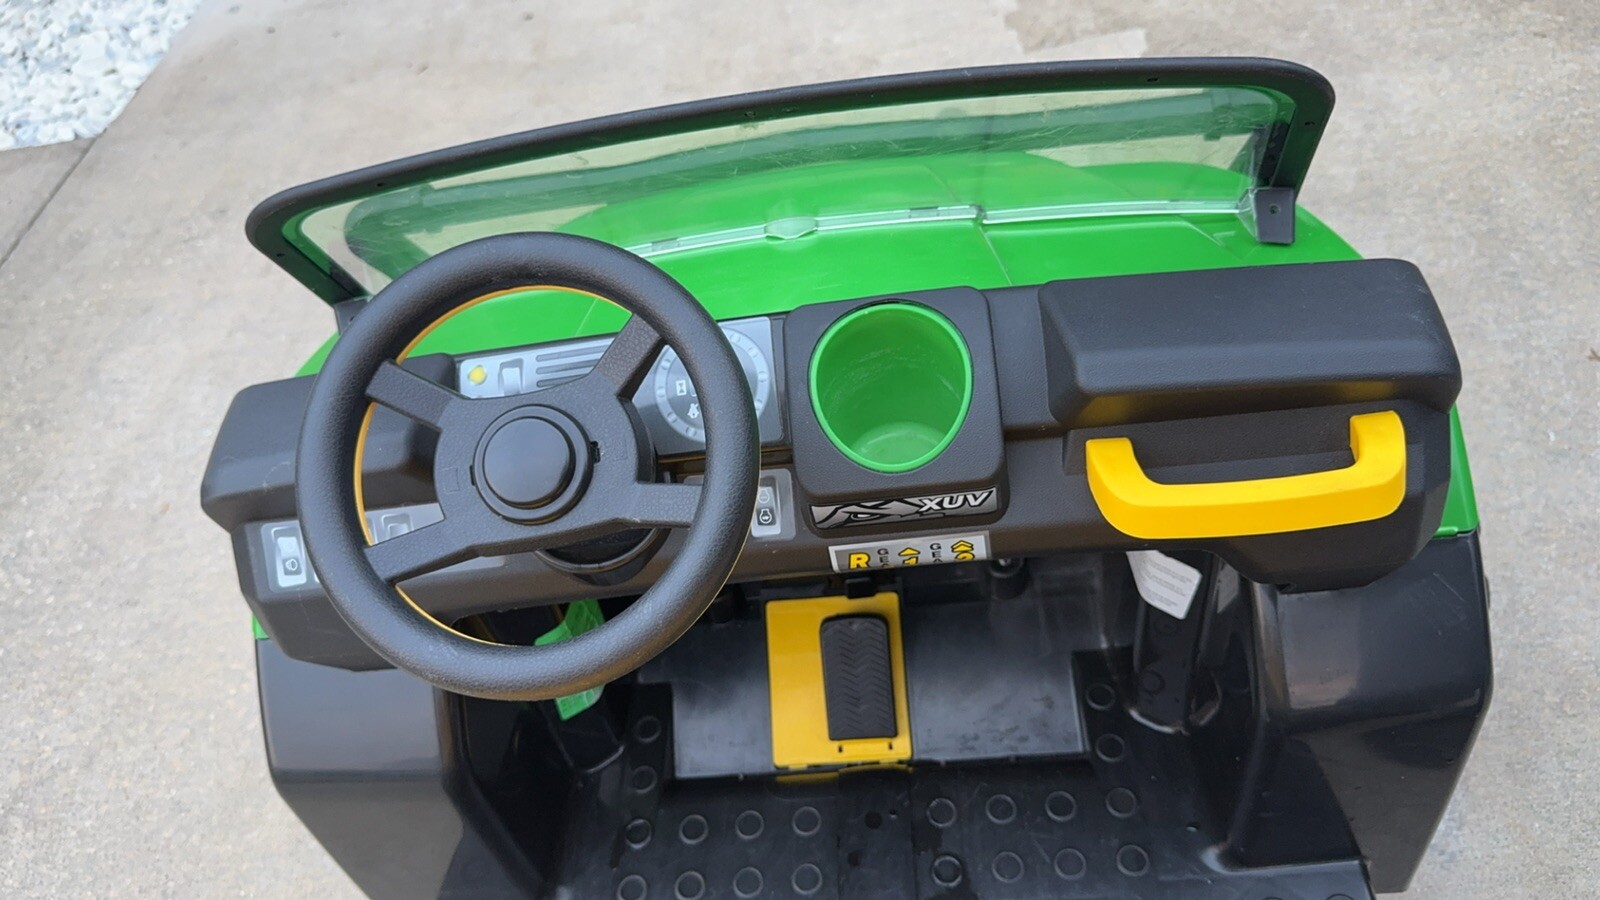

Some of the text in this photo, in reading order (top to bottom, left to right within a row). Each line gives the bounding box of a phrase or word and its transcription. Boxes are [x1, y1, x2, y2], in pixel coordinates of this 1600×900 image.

[919, 490, 993, 512] XUV
[849, 552, 871, 569] R
[930, 543, 943, 563] GEA
